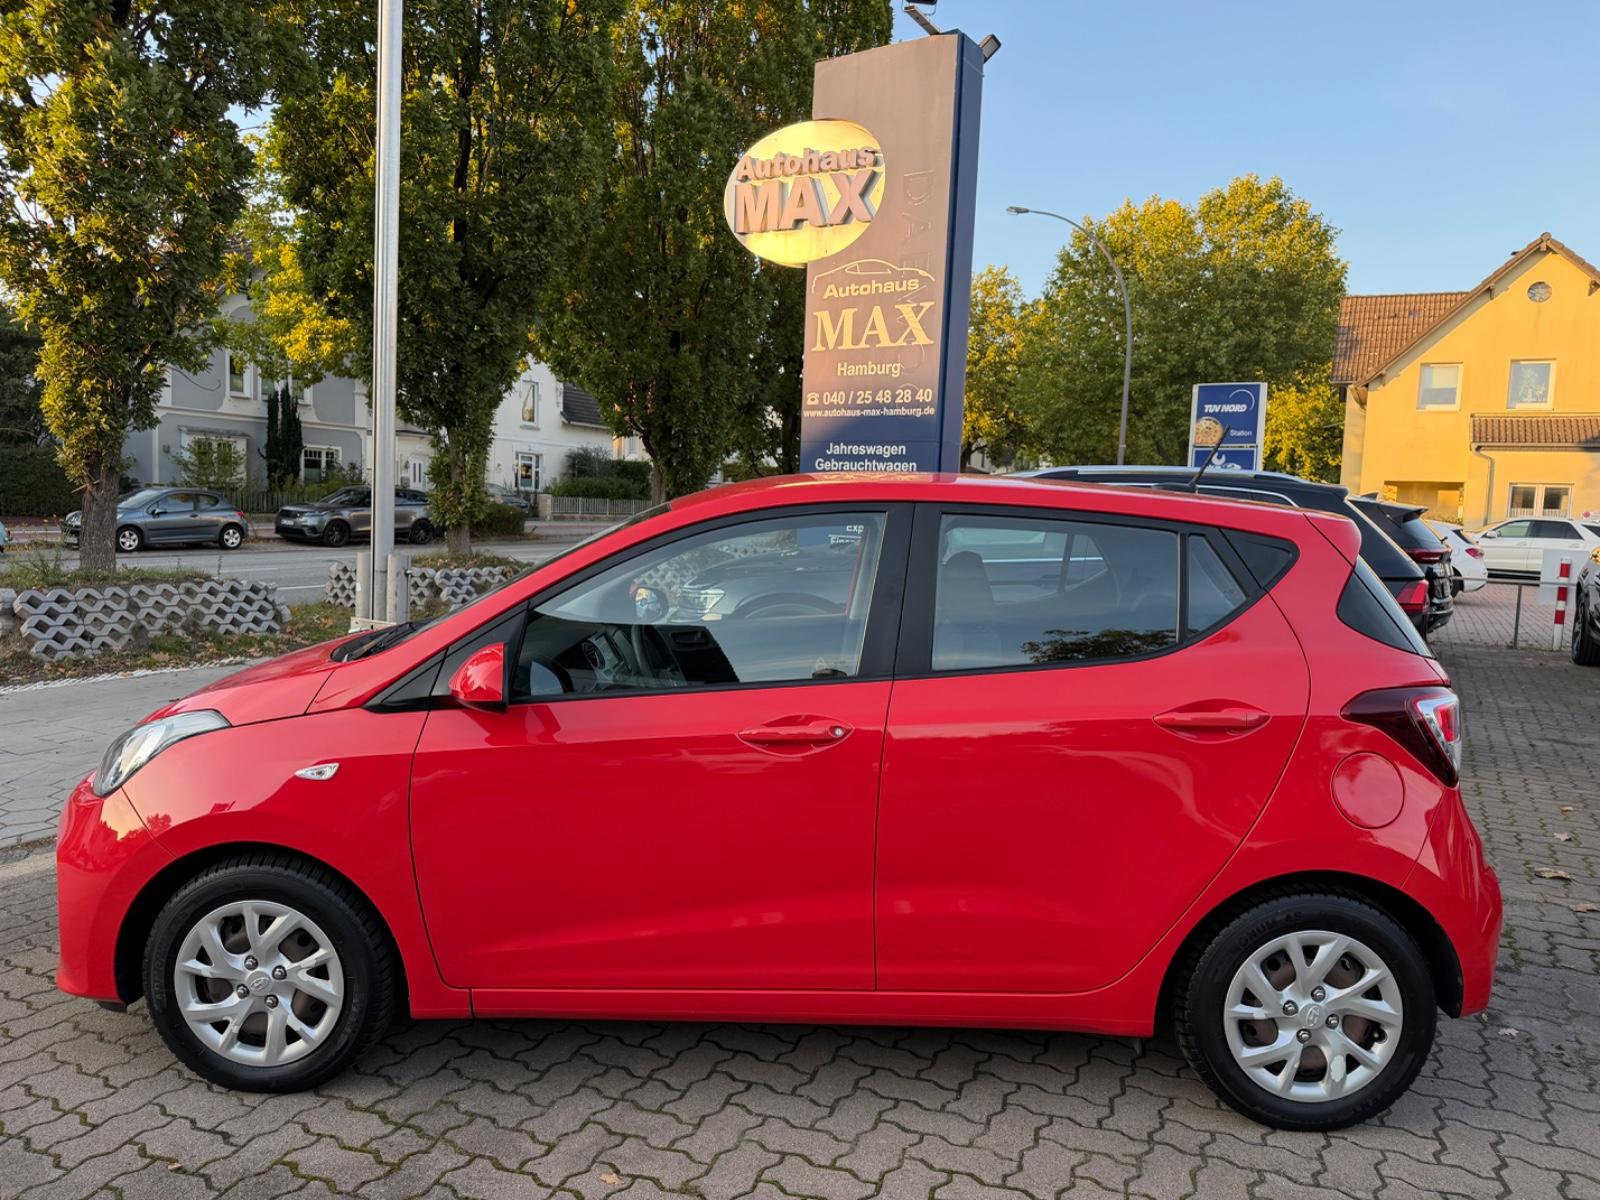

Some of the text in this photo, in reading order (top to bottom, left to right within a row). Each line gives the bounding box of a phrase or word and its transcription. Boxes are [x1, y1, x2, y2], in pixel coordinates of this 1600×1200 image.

[736, 147, 877, 182] Autohaus
[734, 169, 878, 234] MAX
[823, 279, 920, 299] Autohaus
[811, 301, 935, 352] MAX
[837, 362, 901, 377] Hamburg
[823, 388, 932, 405] 040 / 25 48 28 40
[804, 406, 935, 417] www.autohaus-max-hamburg.de
[1221, 404, 1247, 412] NORD
[826, 443, 906, 457] Jahreswagen
[815, 458, 917, 472] Gebrauchtwagen
